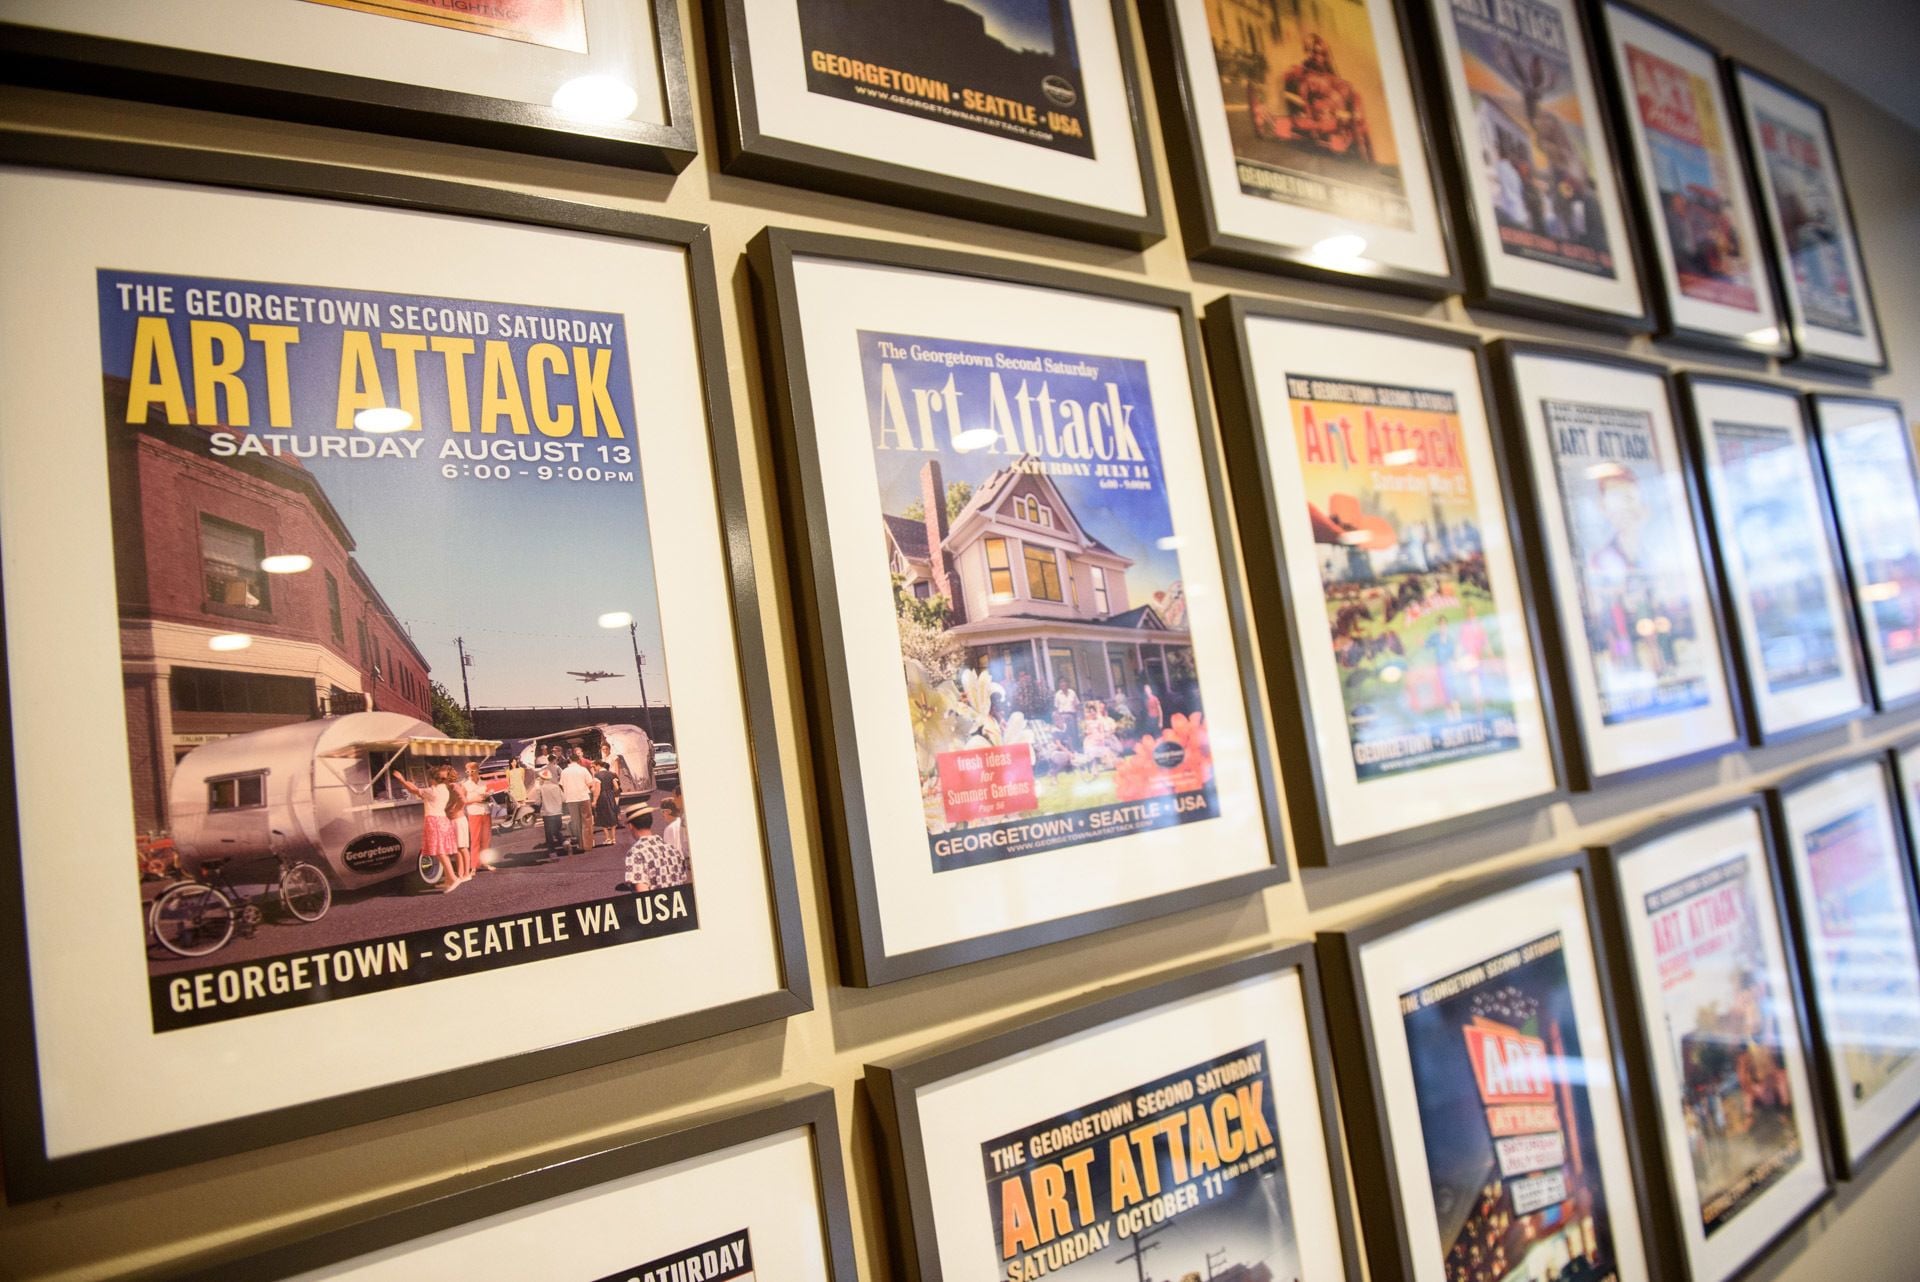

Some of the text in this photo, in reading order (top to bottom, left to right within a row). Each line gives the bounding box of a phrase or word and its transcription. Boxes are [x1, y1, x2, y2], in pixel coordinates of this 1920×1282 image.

[812, 50, 950, 102] GEORGETOWN
[963, 88, 1037, 126] SEATTLE
[1047, 111, 1083, 138] USA
[116, 283, 613, 345] THE GEORGETOWN SECOND SATURDAY
[126, 316, 625, 438] ART ATTACK
[878, 341, 1099, 380] The Georgetown Second Saturday
[878, 362, 1145, 462] Art Attack
[1303, 405, 1464, 468] Art Attack
[209, 432, 632, 464] SATURDAY AUGUST 13
[442, 464, 511, 480] 6:00
[537, 465, 634, 482] 9:00PM
[1559, 428, 1649, 459] ART ATTACK
[957, 752, 1012, 771] fresh ideas
[981, 771, 995, 783] for
[948, 782, 1029, 805] Summer Gardens
[346, 844, 400, 861] Georgetown
[934, 795, 1207, 857] GEORGETOWN SEATTLE USA
[168, 939, 409, 1012] GEORGETOWN
[444, 911, 569, 961] SEATTLE
[576, 903, 620, 936] WA
[635, 891, 688, 926] USA
[1482, 1036, 1546, 1095] ART
[990, 1053, 1262, 1173] THE GEORGETOWN SECOND SATURDAY
[1002, 1080, 1273, 1260] ART ATTACK
[1006, 1220, 1110, 1282] SATURDAY
[1117, 1182, 1199, 1240] OCTOBER
[1202, 1171, 1223, 1200] 11
[626, 1239, 745, 1282] TURDAY
